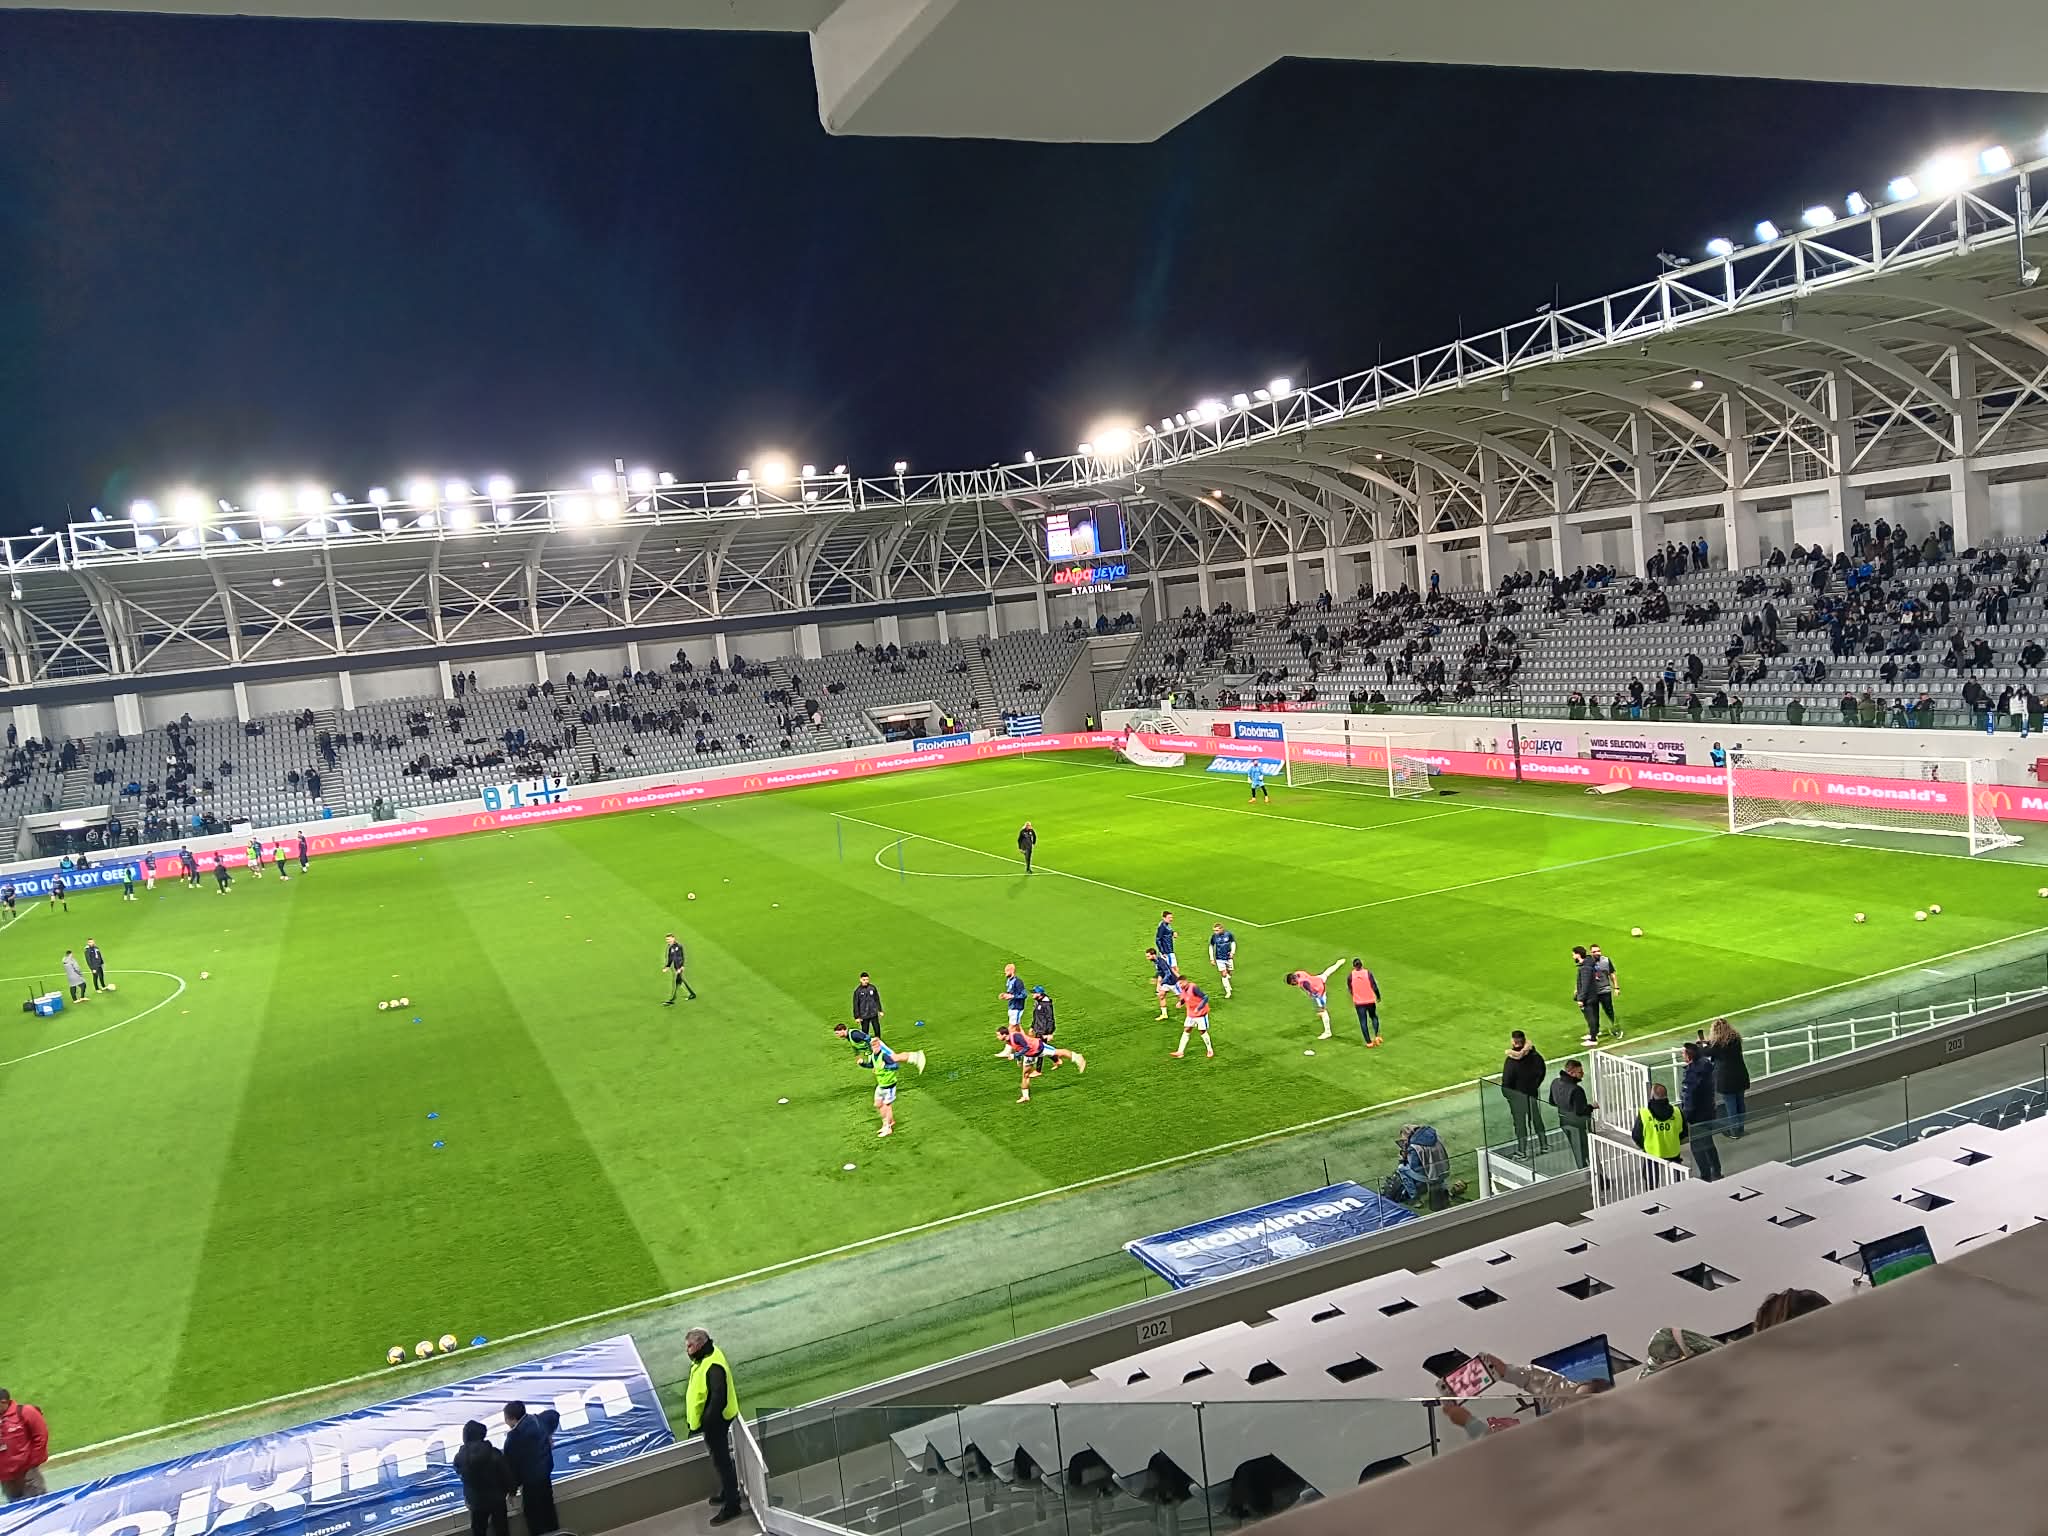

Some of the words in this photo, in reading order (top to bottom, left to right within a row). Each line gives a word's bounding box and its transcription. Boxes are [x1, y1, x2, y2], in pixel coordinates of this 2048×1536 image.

[1072, 584, 1112, 596] STADIUM
[997, 738, 1060, 751] McDonald's
[1219, 743, 1263, 753] McDonald's
[1507, 737, 1563, 754] αφαμεγα
[1590, 739, 1608, 747] WIDE
[1610, 740, 1646, 749] SELECTION
[1657, 742, 1684, 751] OFFERS
[876, 753, 944, 768] McDonald's
[767, 768, 839, 784] McDonald's
[626, 786, 704, 804] McDonald's
[1828, 783, 1948, 803] McDonald's
[500, 804, 583, 822] McDonald's
[340, 826, 428, 845] McDonald's
[1948, 1038, 1962, 1051] 203
[1654, 1122, 1671, 1132] 160
[1166, 1196, 1365, 1259] Stoiximan
[1142, 1320, 1167, 1339] 202
